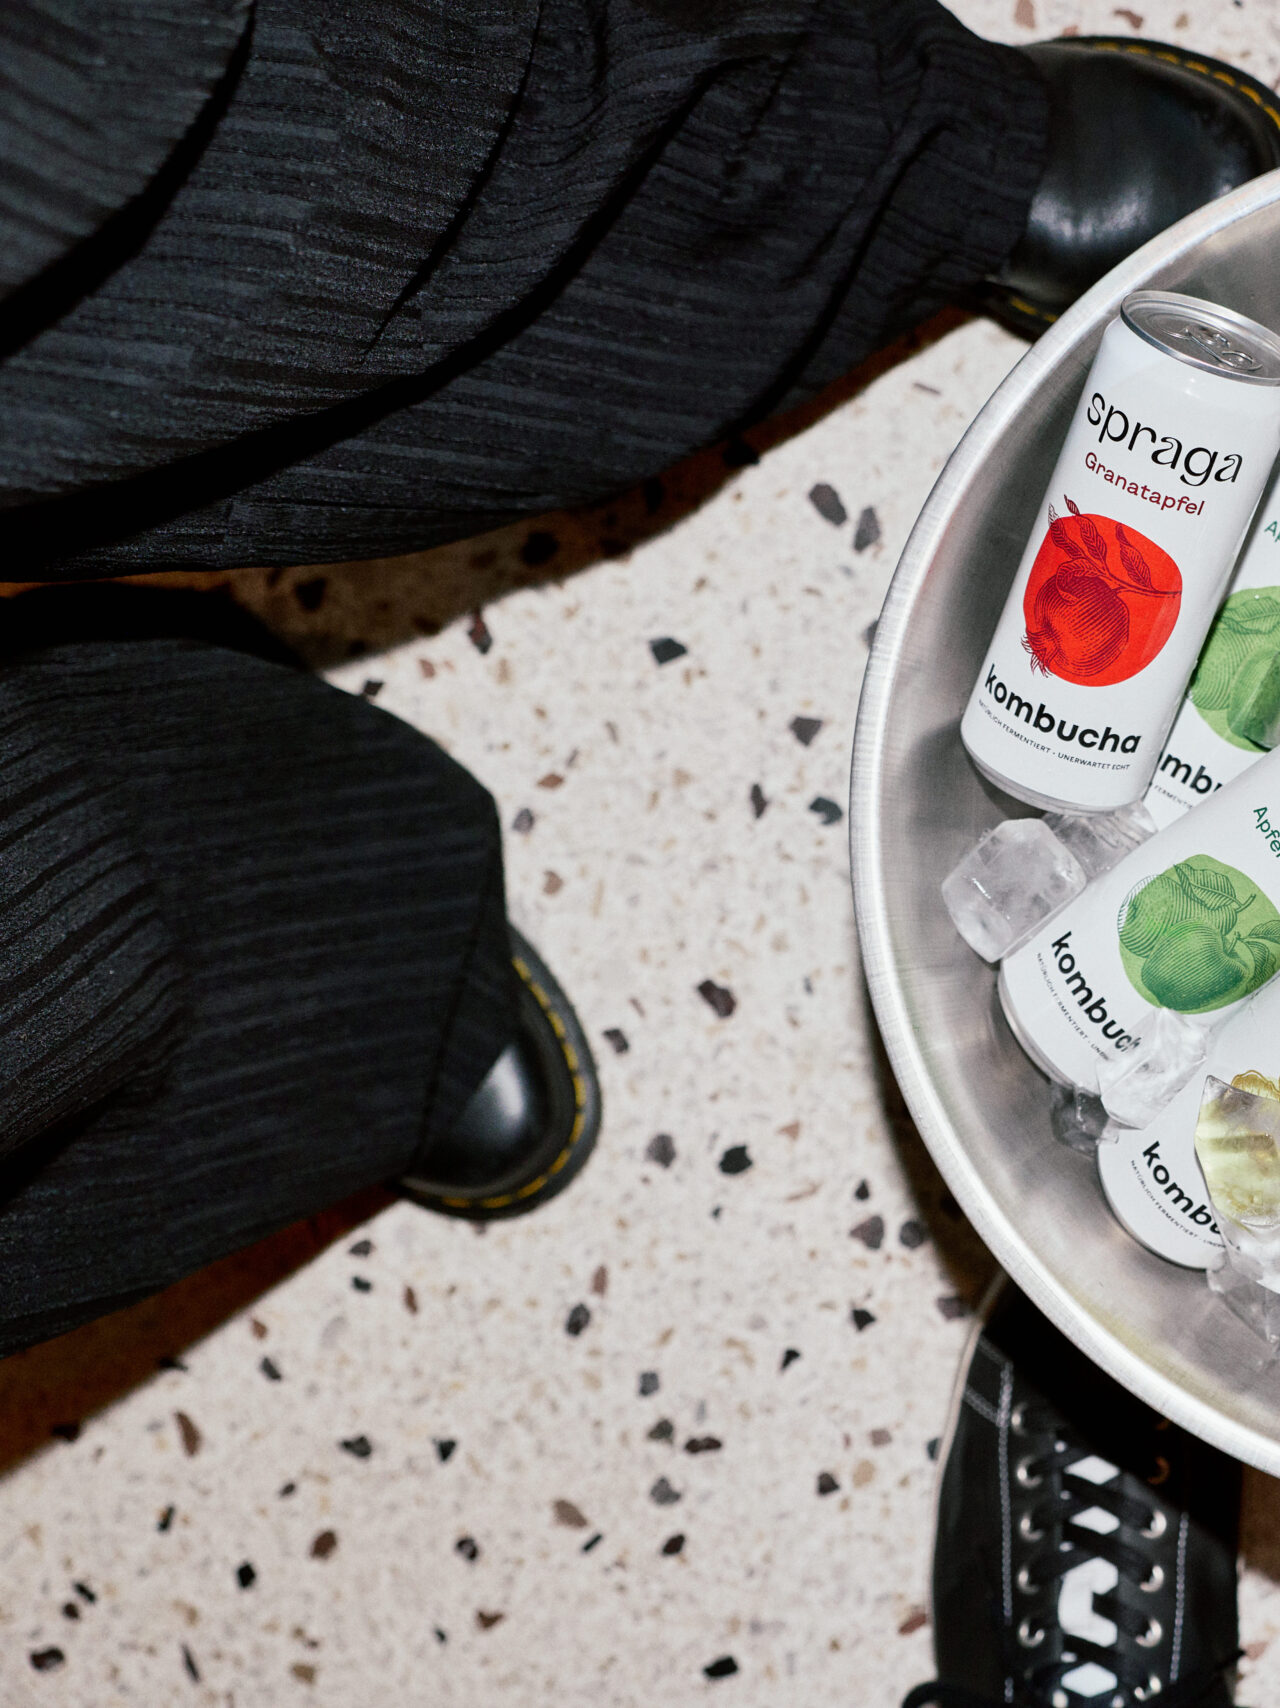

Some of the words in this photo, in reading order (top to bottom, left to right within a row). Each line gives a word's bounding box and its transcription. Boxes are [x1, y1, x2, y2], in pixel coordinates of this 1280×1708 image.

[1087, 392, 1243, 486] spraga
[1085, 452, 1205, 516] Granatapfel
[985, 663, 1142, 753] kombucha
[1003, 723, 1051, 754] FERMENTIERT
[1057, 752, 1111, 770] UNERWARTET
[1111, 763, 1130, 771] ECHT
